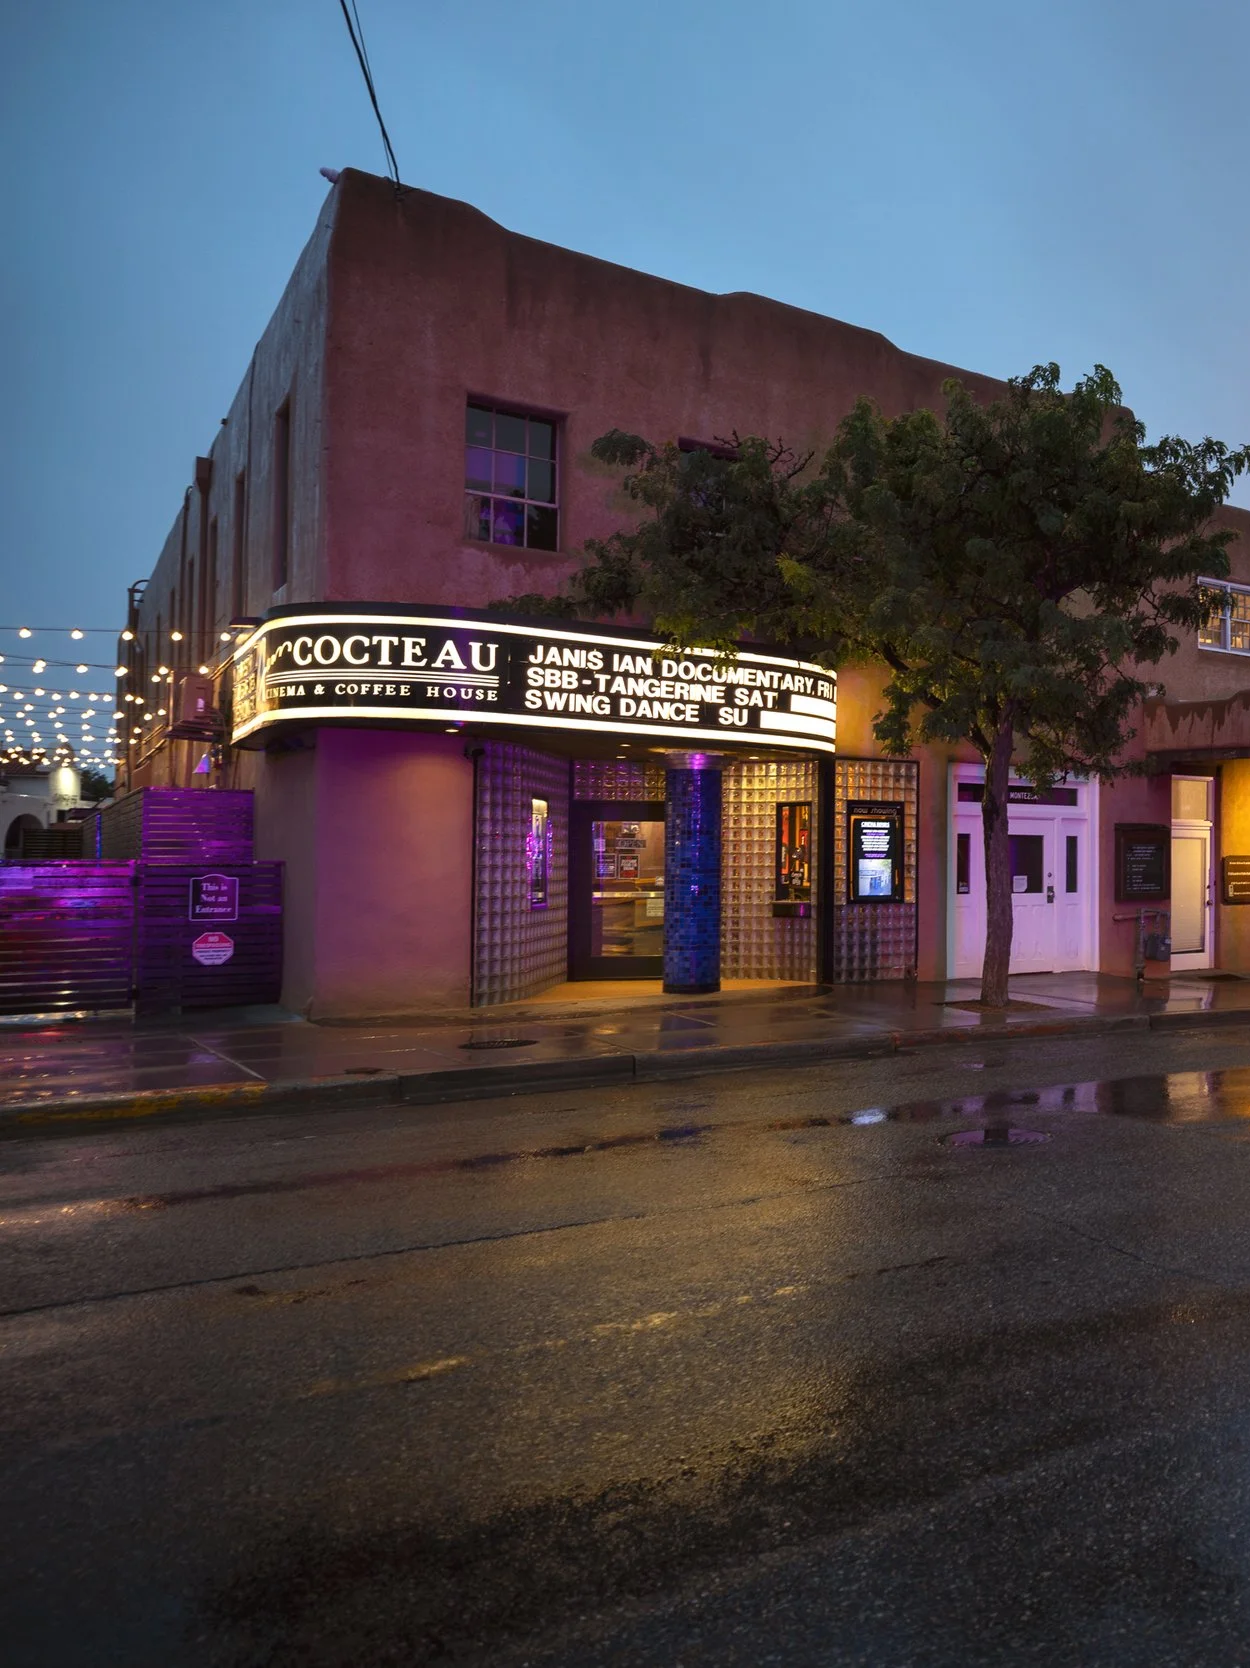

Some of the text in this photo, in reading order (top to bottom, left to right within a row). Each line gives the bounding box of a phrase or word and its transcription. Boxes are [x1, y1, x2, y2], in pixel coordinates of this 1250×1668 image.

[292, 635, 499, 672] COCTEAU
[528, 645, 604, 670] JANIS
[613, 654, 653, 675] IAN
[266, 683, 498, 701] CINEMA & COFFEE HOUSE
[734, 687, 777, 709] SAT
[524, 689, 749, 726] SWING DANCE SU
[870, 808, 898, 817] showing
[201, 883, 228, 891] This is
[201, 894, 216, 902] Not
[195, 905, 232, 913] Entrance
